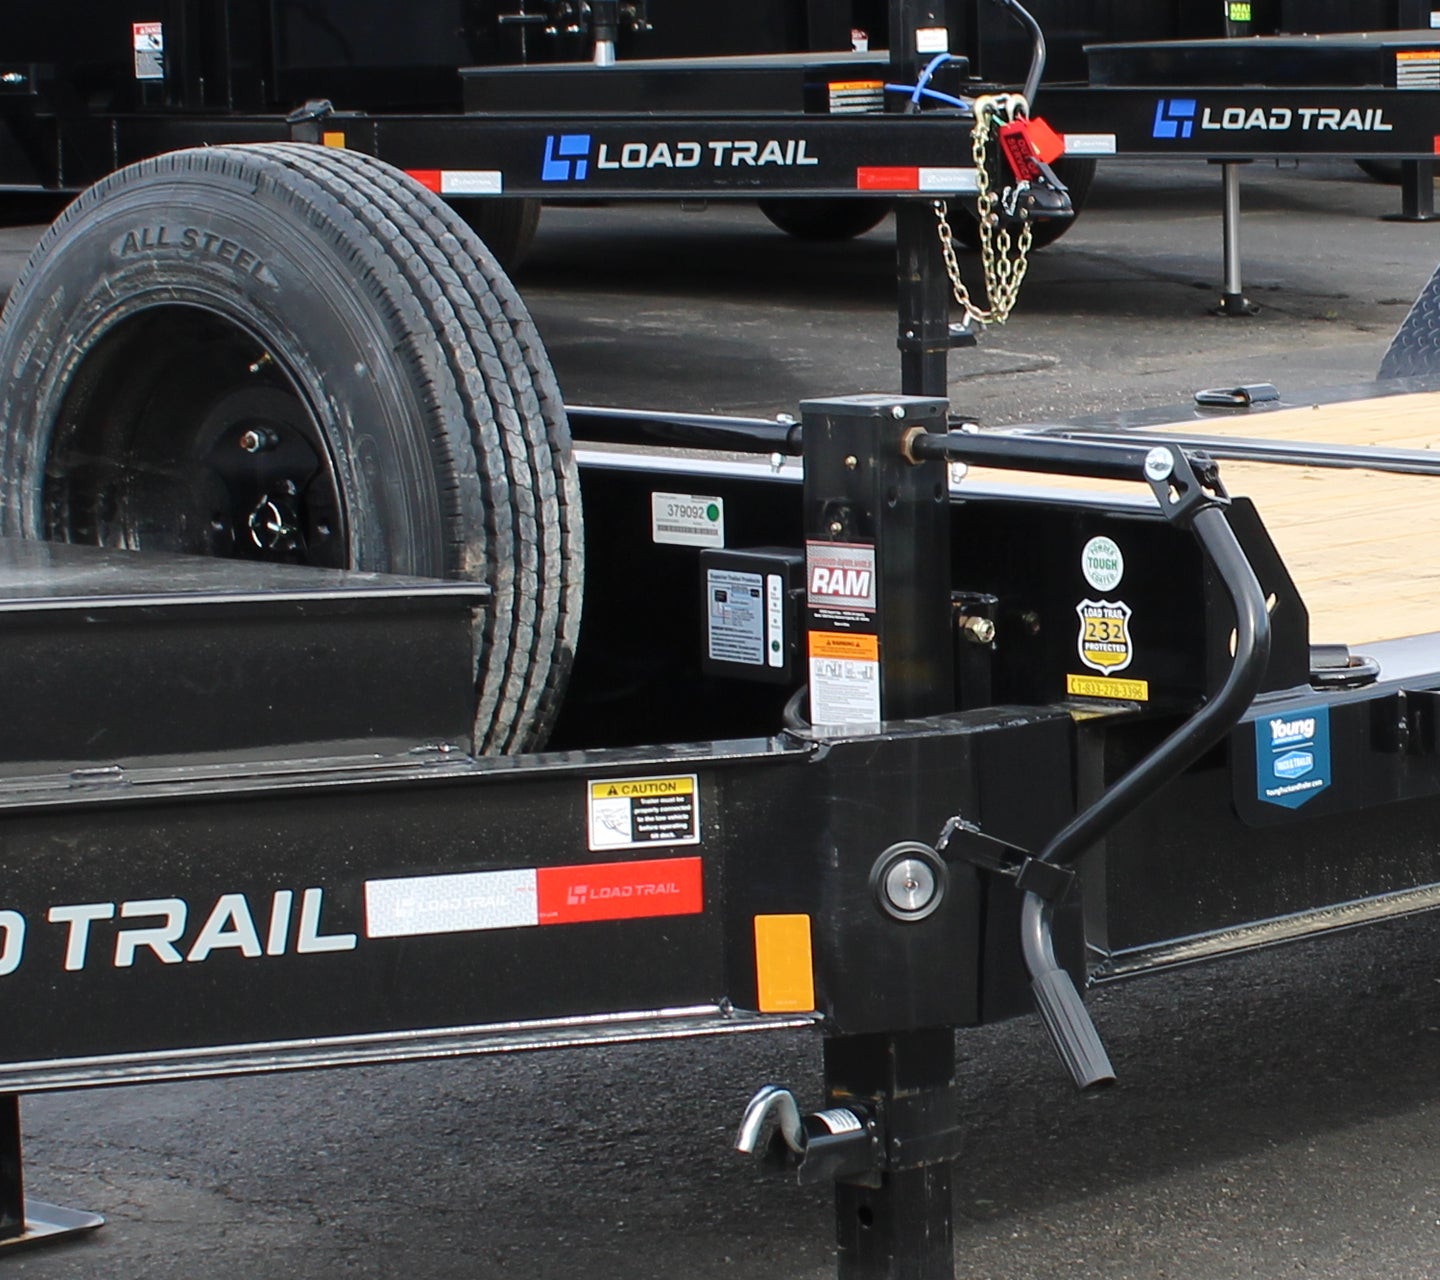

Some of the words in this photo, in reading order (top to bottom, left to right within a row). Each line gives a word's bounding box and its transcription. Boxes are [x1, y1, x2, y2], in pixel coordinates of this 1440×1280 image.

[1201, 106, 1293, 131] LOAD
[1297, 107, 1394, 131] TRAIL
[597, 141, 701, 169] LOAD
[707, 139, 819, 167] TRAIL
[120, 225, 171, 257] ALL
[180, 227, 267, 278] STEEL
[667, 503, 705, 520] 379092
[1087, 556, 1118, 571] TOUGH
[811, 567, 871, 597] RAM
[1084, 607, 1103, 618] LOAD
[1103, 608, 1124, 619] TRAIL
[1088, 621, 1122, 642] 232
[1084, 641, 1127, 653] PROTECTED
[1270, 718, 1315, 739] Young
[621, 782, 677, 796] CAUTION
[640, 797, 659, 805] Trailer
[659, 796, 676, 804] must
[634, 806, 659, 815] properly
[659, 804, 692, 813] connected
[667, 813, 690, 821] vehicle
[638, 824, 659, 832] before
[659, 822, 688, 831] operating
[589, 885, 632, 900] LOAD
[634, 881, 681, 896] TRAIL
[47, 886, 358, 972] TRAIL
